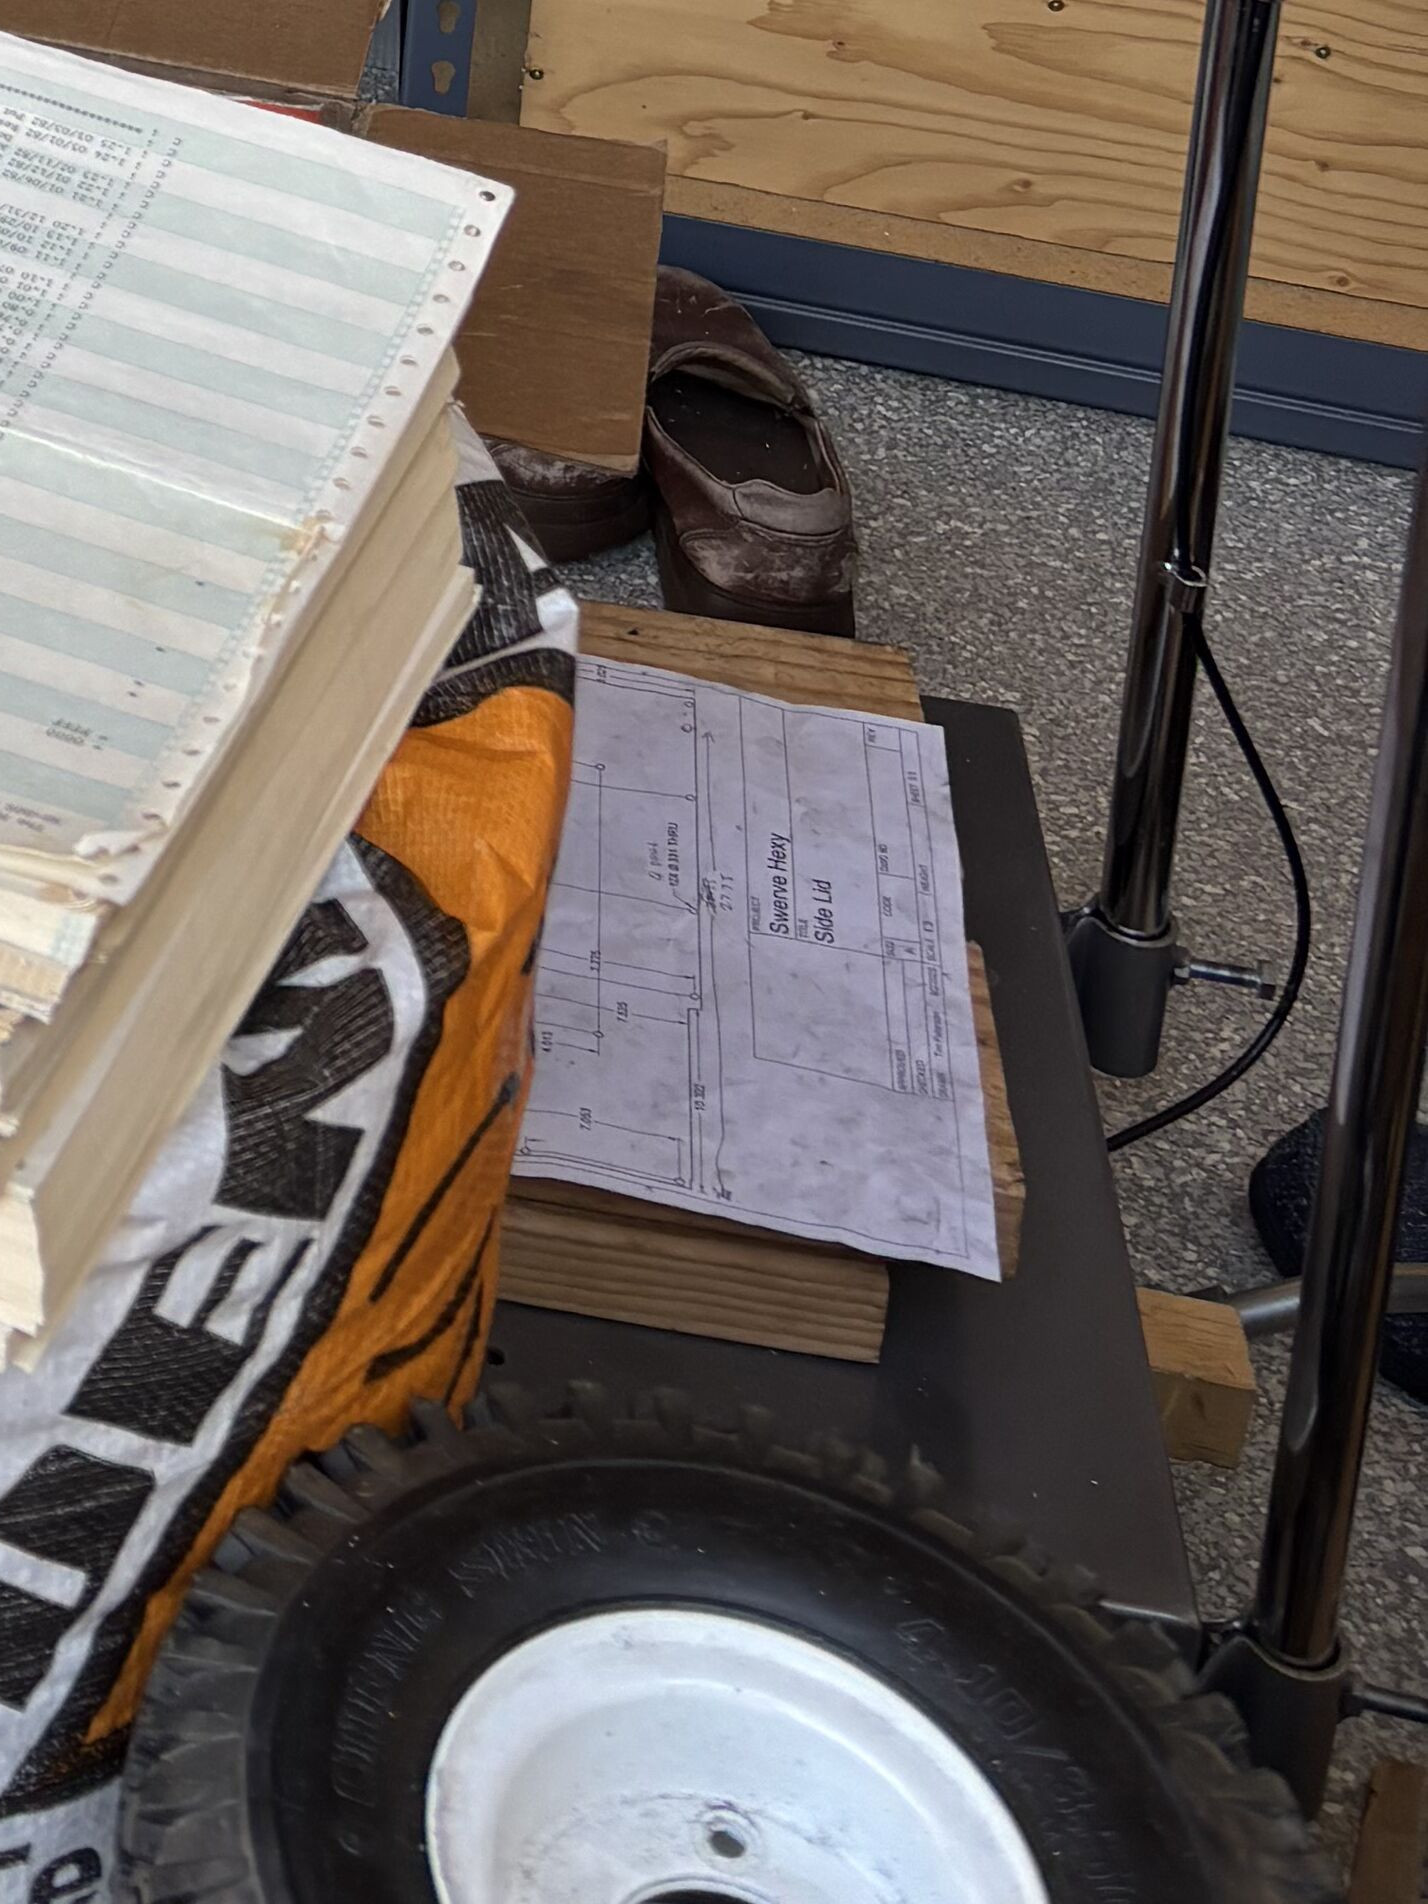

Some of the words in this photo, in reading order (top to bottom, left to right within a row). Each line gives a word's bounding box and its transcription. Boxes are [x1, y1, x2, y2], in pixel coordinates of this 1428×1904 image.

[767, 833, 791, 871] Hexy
[769, 876, 789, 934] Swerve
[812, 879, 832, 903] Lid
[813, 908, 834, 943] Side
